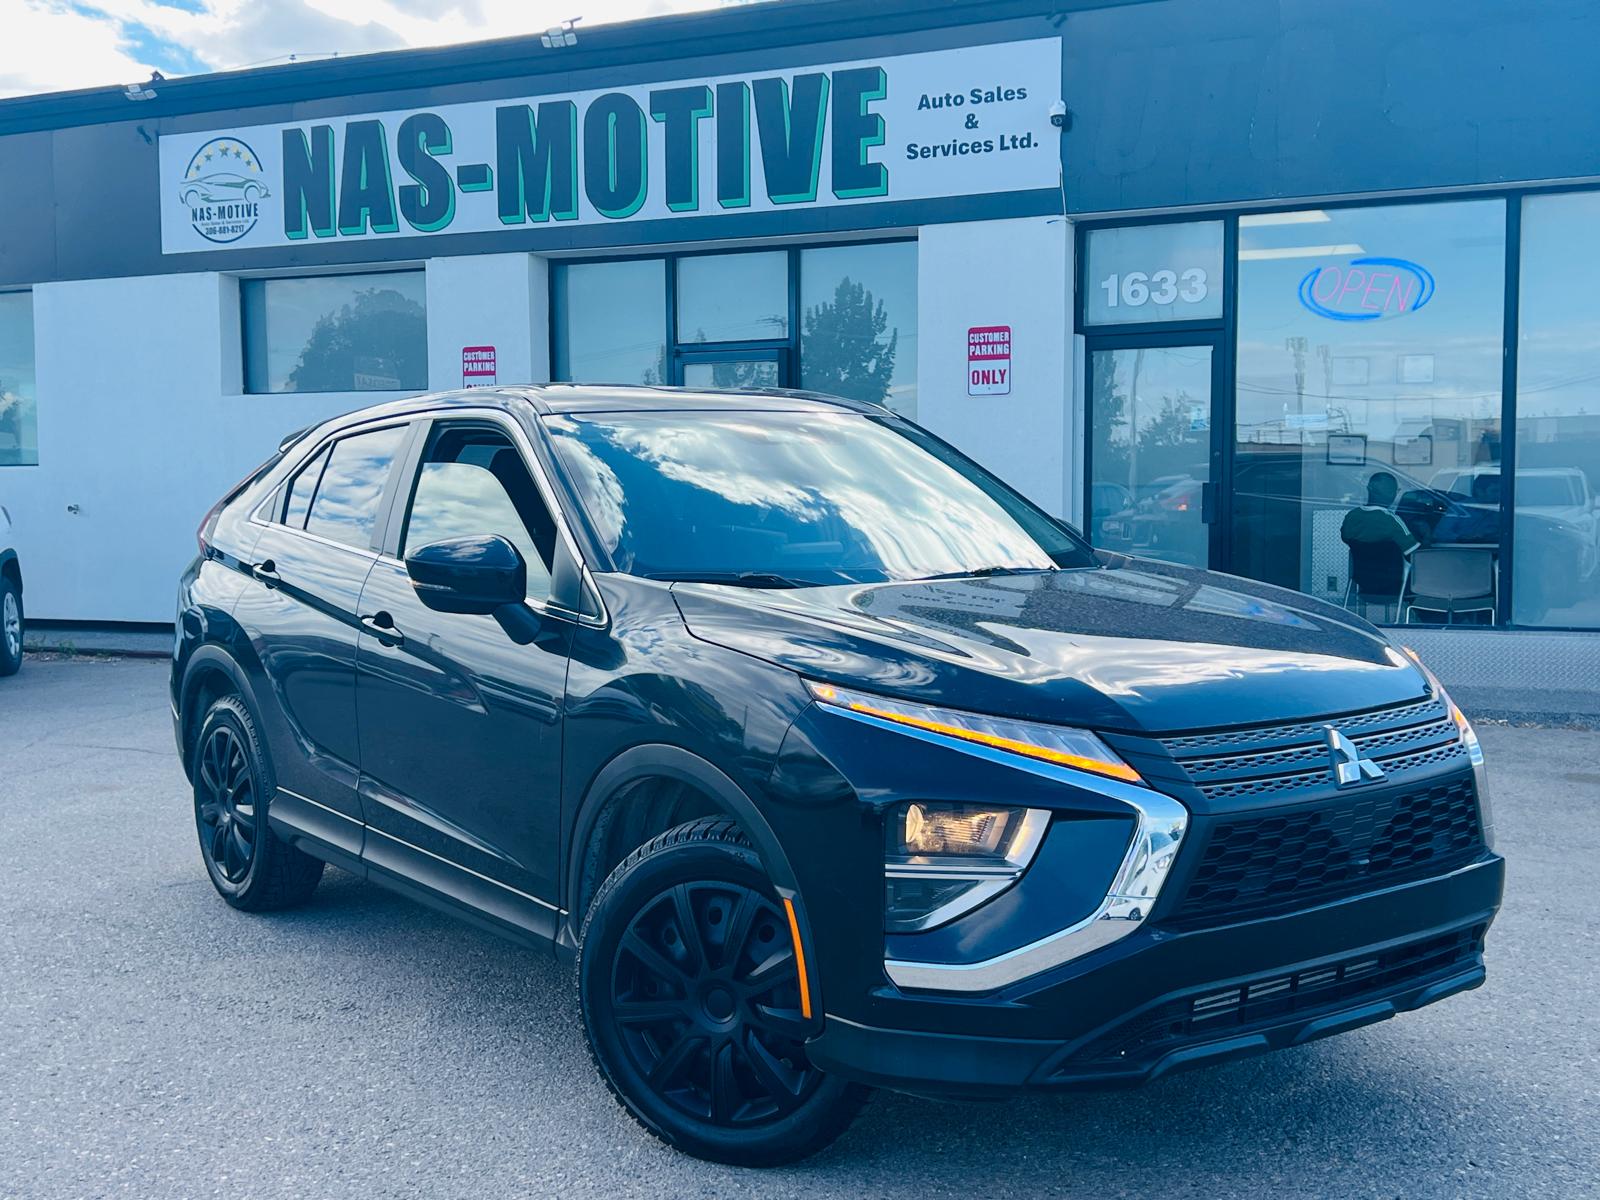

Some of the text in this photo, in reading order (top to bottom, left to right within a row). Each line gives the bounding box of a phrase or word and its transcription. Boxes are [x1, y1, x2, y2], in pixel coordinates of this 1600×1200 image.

[917, 86, 1027, 110] Auto Sales
[964, 113, 979, 130] &
[282, 66, 888, 240] NAS-MOTIVE
[906, 132, 1039, 160] Services Ltd.
[191, 203, 259, 222] NAS-MOTIVE
[1101, 268, 1208, 307] 1633
[1314, 266, 1414, 312] OPEN
[969, 332, 1010, 344] CUSTOMER
[463, 351, 495, 361] CUSTOMER
[969, 344, 1010, 356] PARKING
[463, 361, 495, 372] PARKING
[971, 369, 1007, 386] ONLY
